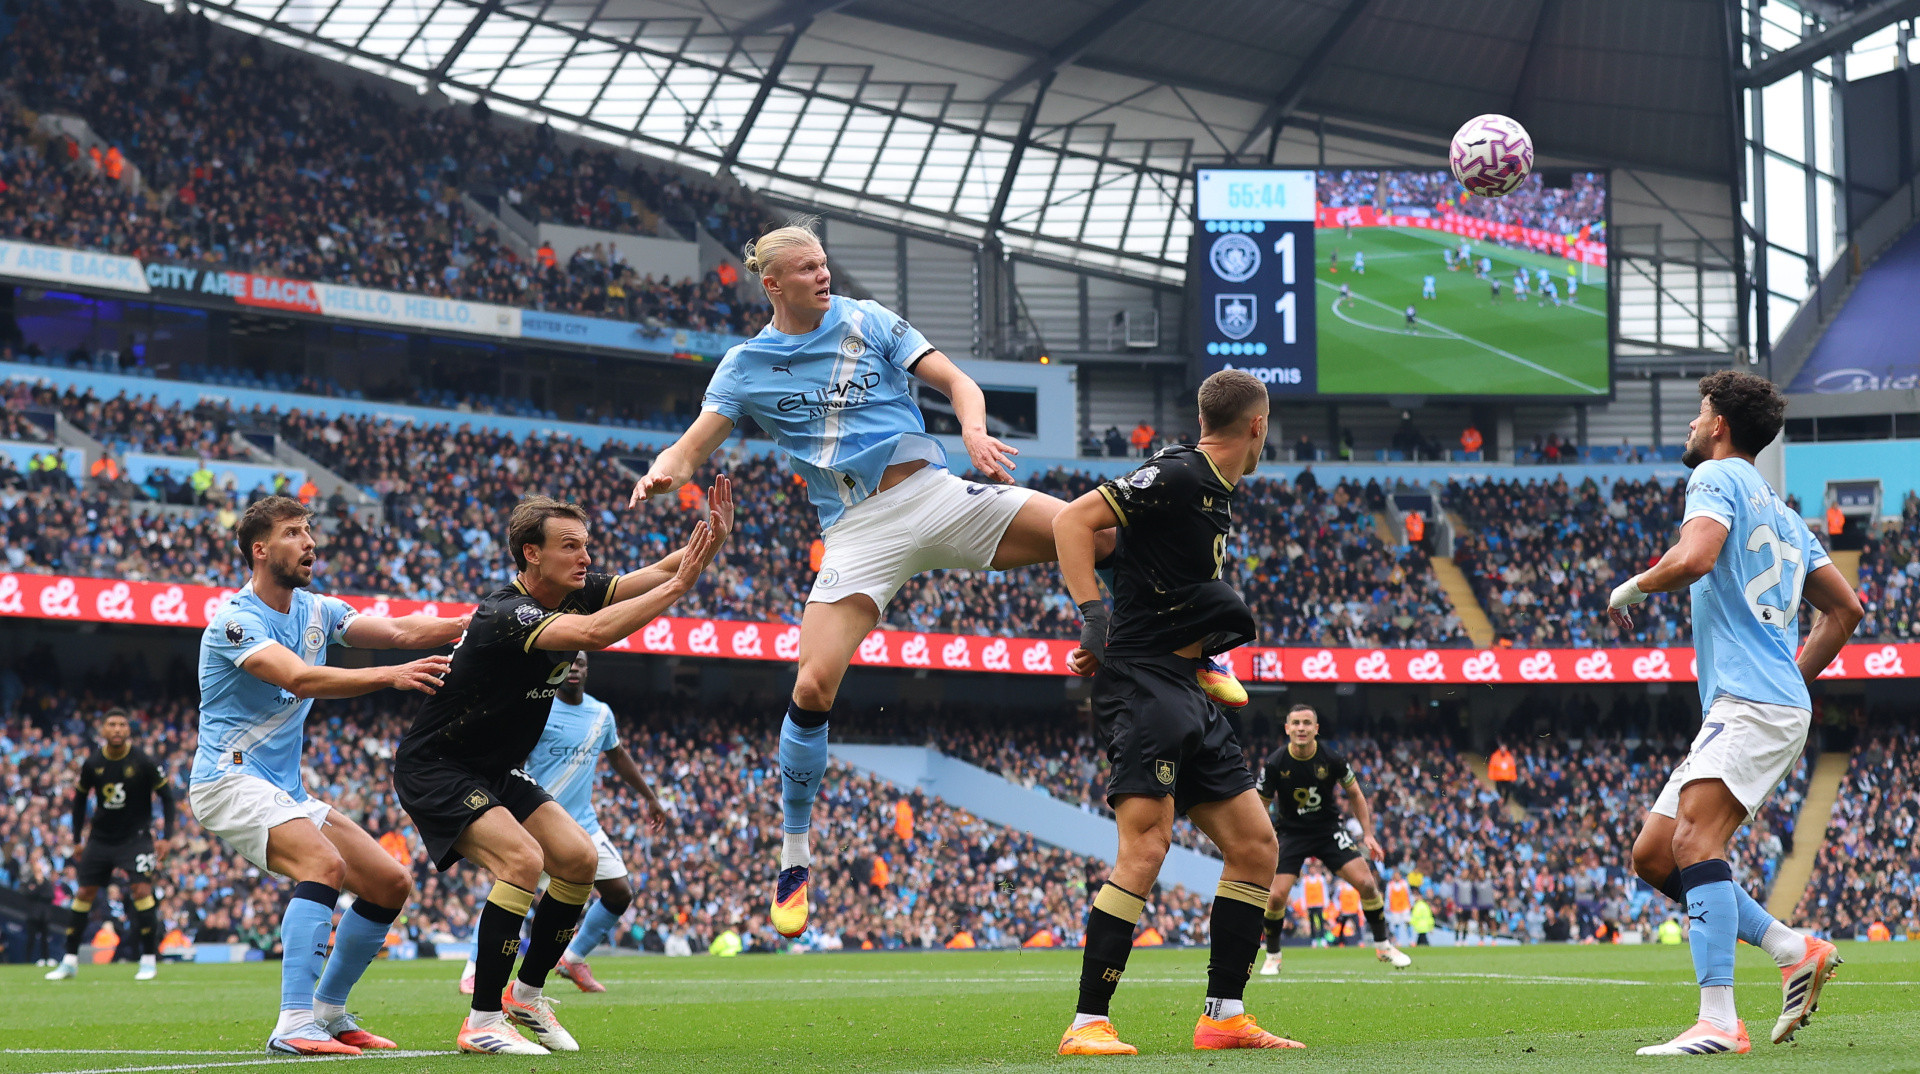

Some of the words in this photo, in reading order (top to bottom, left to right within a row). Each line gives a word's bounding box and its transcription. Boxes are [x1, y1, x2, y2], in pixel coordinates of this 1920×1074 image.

[1228, 183, 1287, 209] 55:44
[17, 248, 62, 273] ARE
[1274, 232, 1296, 285] 1
[145, 263, 198, 291] CITY
[201, 269, 247, 298] ARE
[252, 278, 318, 311] BACK,
[325, 288, 398, 320] HELLO,
[405, 297, 477, 325] HELLO.
[1275, 291, 1297, 344] 1
[565, 323, 588, 335] CITY
[1222, 362, 1302, 385] ronis
[777, 372, 880, 412] ETIHAD
[809, 395, 869, 420] AIRWAYS
[1744, 524, 1805, 630] 27
[103, 783, 126, 804] 96
[1293, 786, 1322, 809] 96
[1687, 900, 1704, 910] ITY
